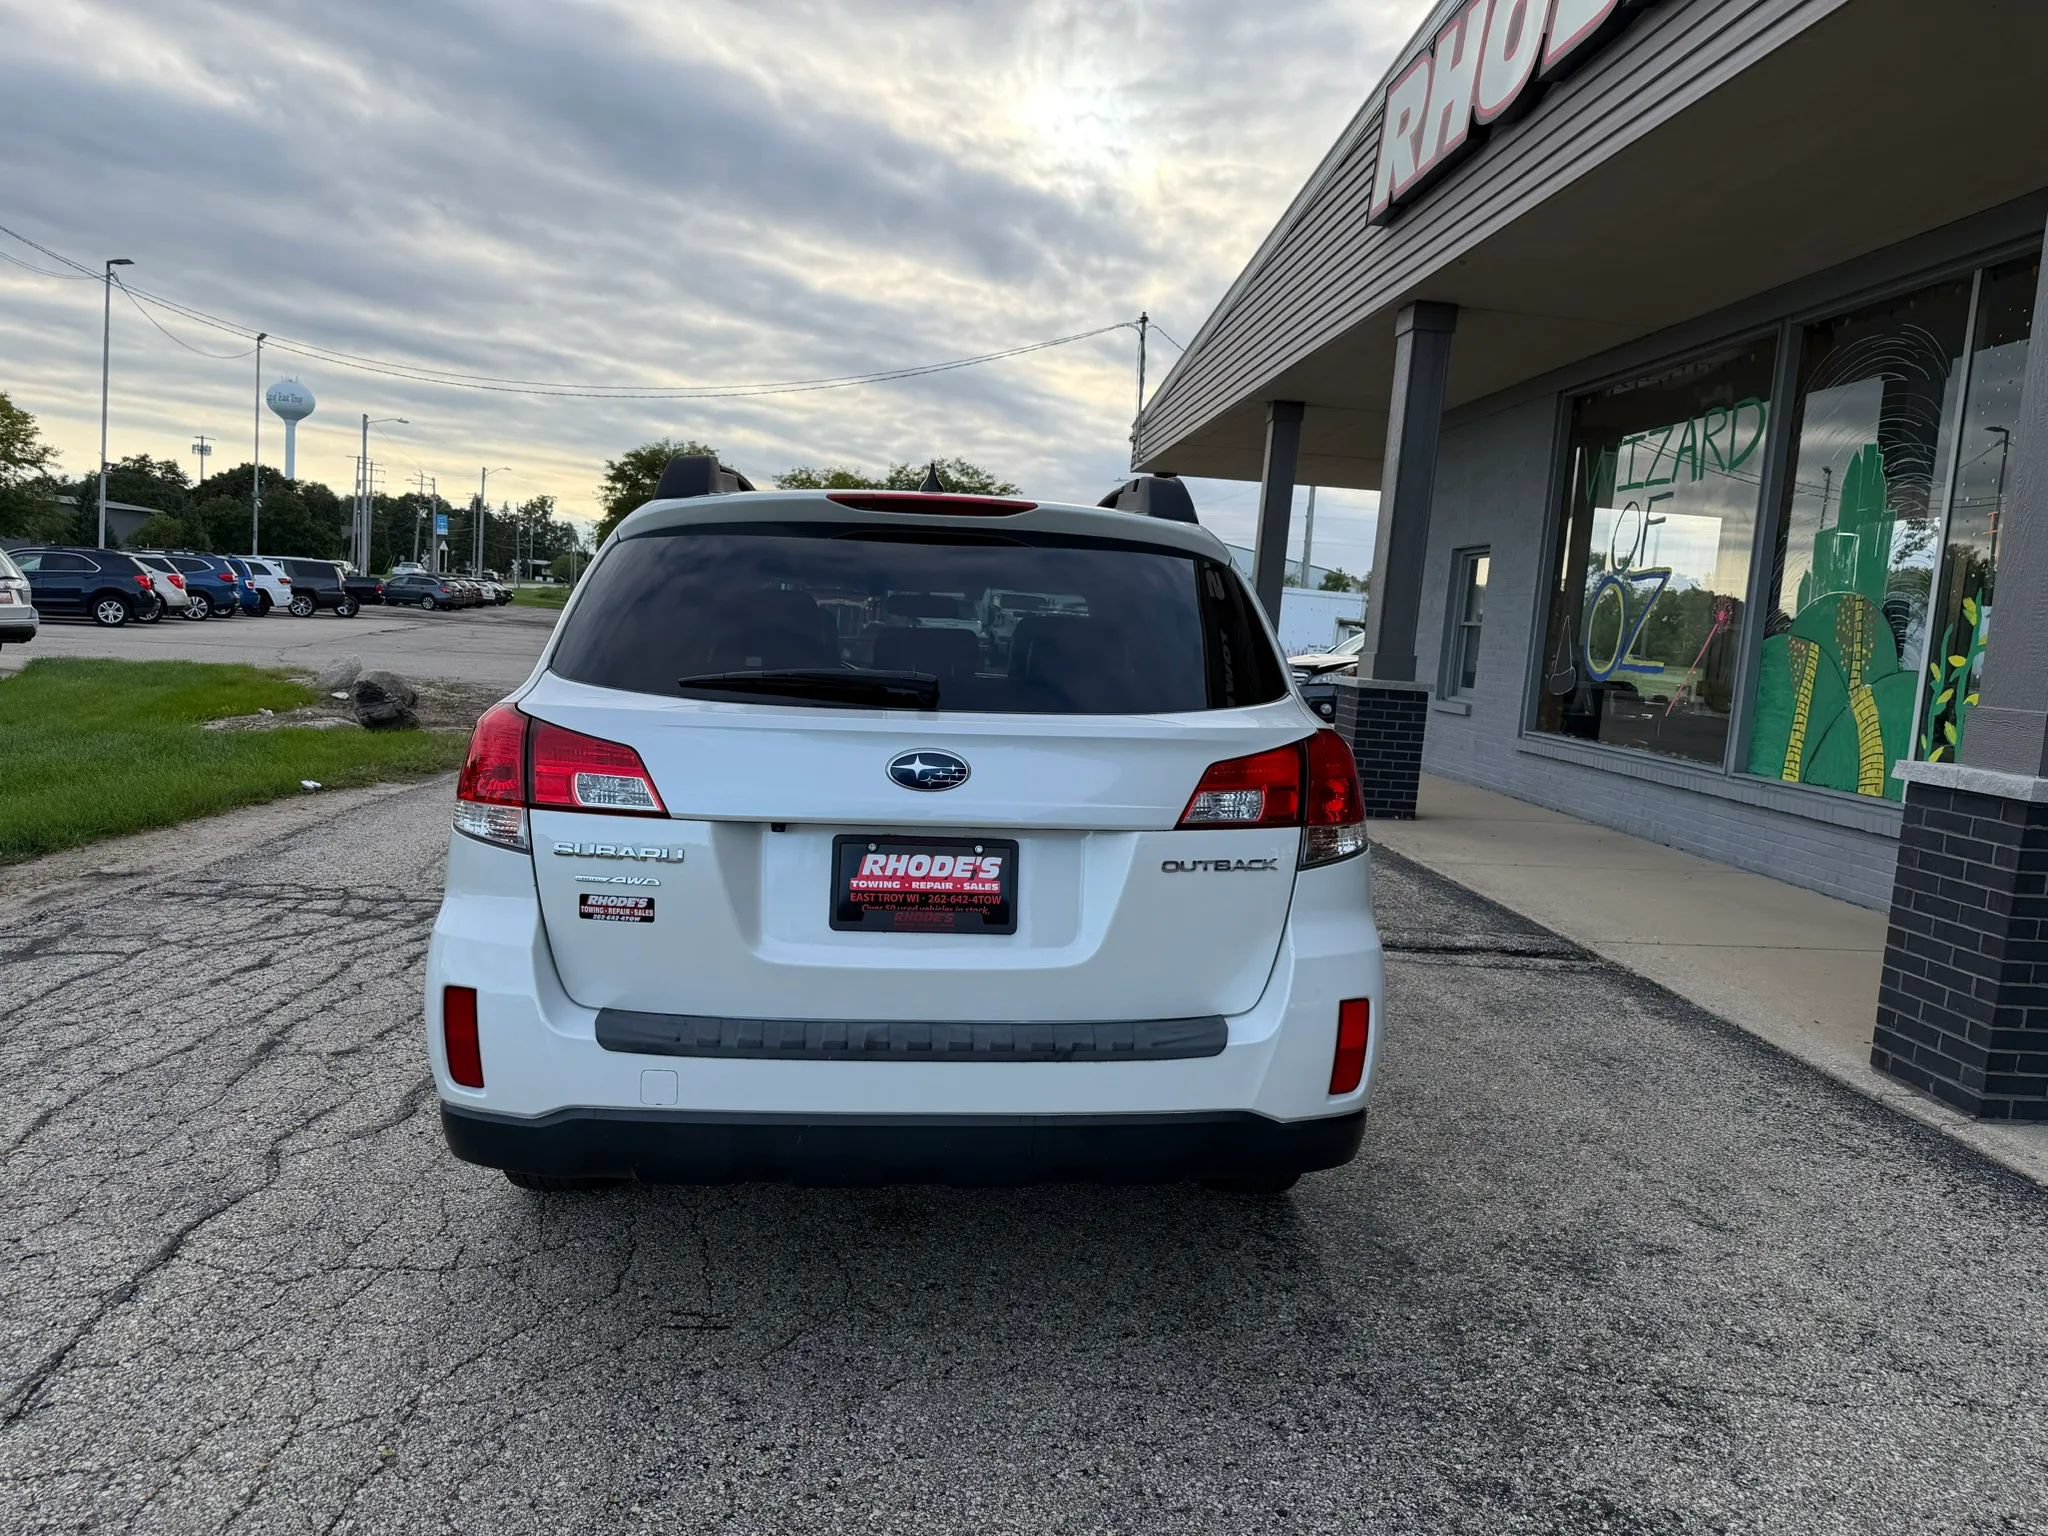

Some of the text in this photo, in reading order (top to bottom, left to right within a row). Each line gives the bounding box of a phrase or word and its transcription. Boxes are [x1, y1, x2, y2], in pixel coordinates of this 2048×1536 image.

[278, 391, 290, 402] East
[290, 393, 304, 406] Troy
[1584, 397, 1767, 503] WIZARD
[1611, 492, 1674, 575] OF
[1584, 567, 1672, 682] OZ
[553, 841, 685, 863] SUBARU
[858, 853, 1003, 880] RHODE'S
[1161, 858, 1279, 873] OUTBACK
[608, 876, 662, 886] AWD
[850, 880, 999, 891] TOWING REPAIR SALES
[586, 895, 649, 908] RHODE'S
[850, 892, 1002, 905] EAST TROY WI 262-642-4TOW
[581, 905, 654, 917] TOWING REPAIR SALES
